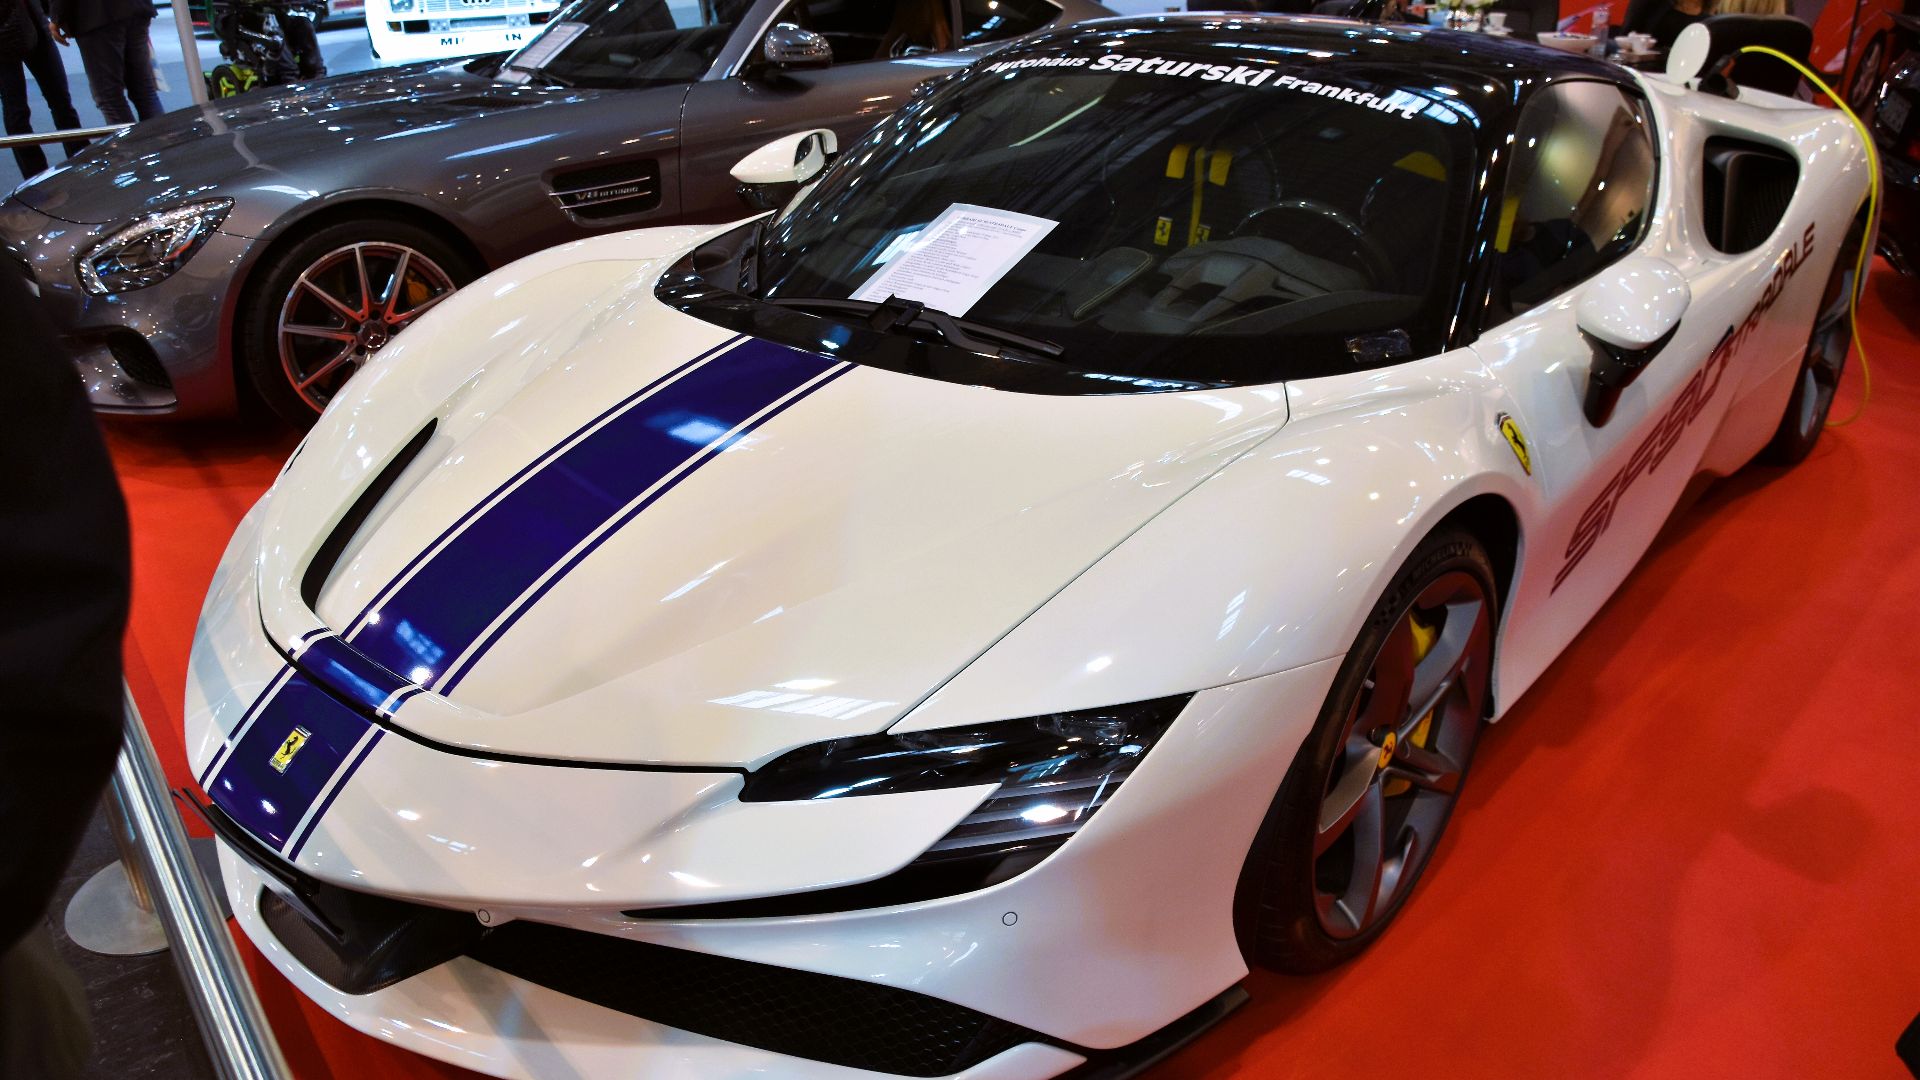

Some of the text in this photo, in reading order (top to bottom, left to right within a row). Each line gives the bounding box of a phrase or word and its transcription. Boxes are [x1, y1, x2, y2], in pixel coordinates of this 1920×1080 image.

[982, 54, 1419, 119] Autohaus Saturski Frankfurt
[1719, 222, 1815, 370] STRADALE
